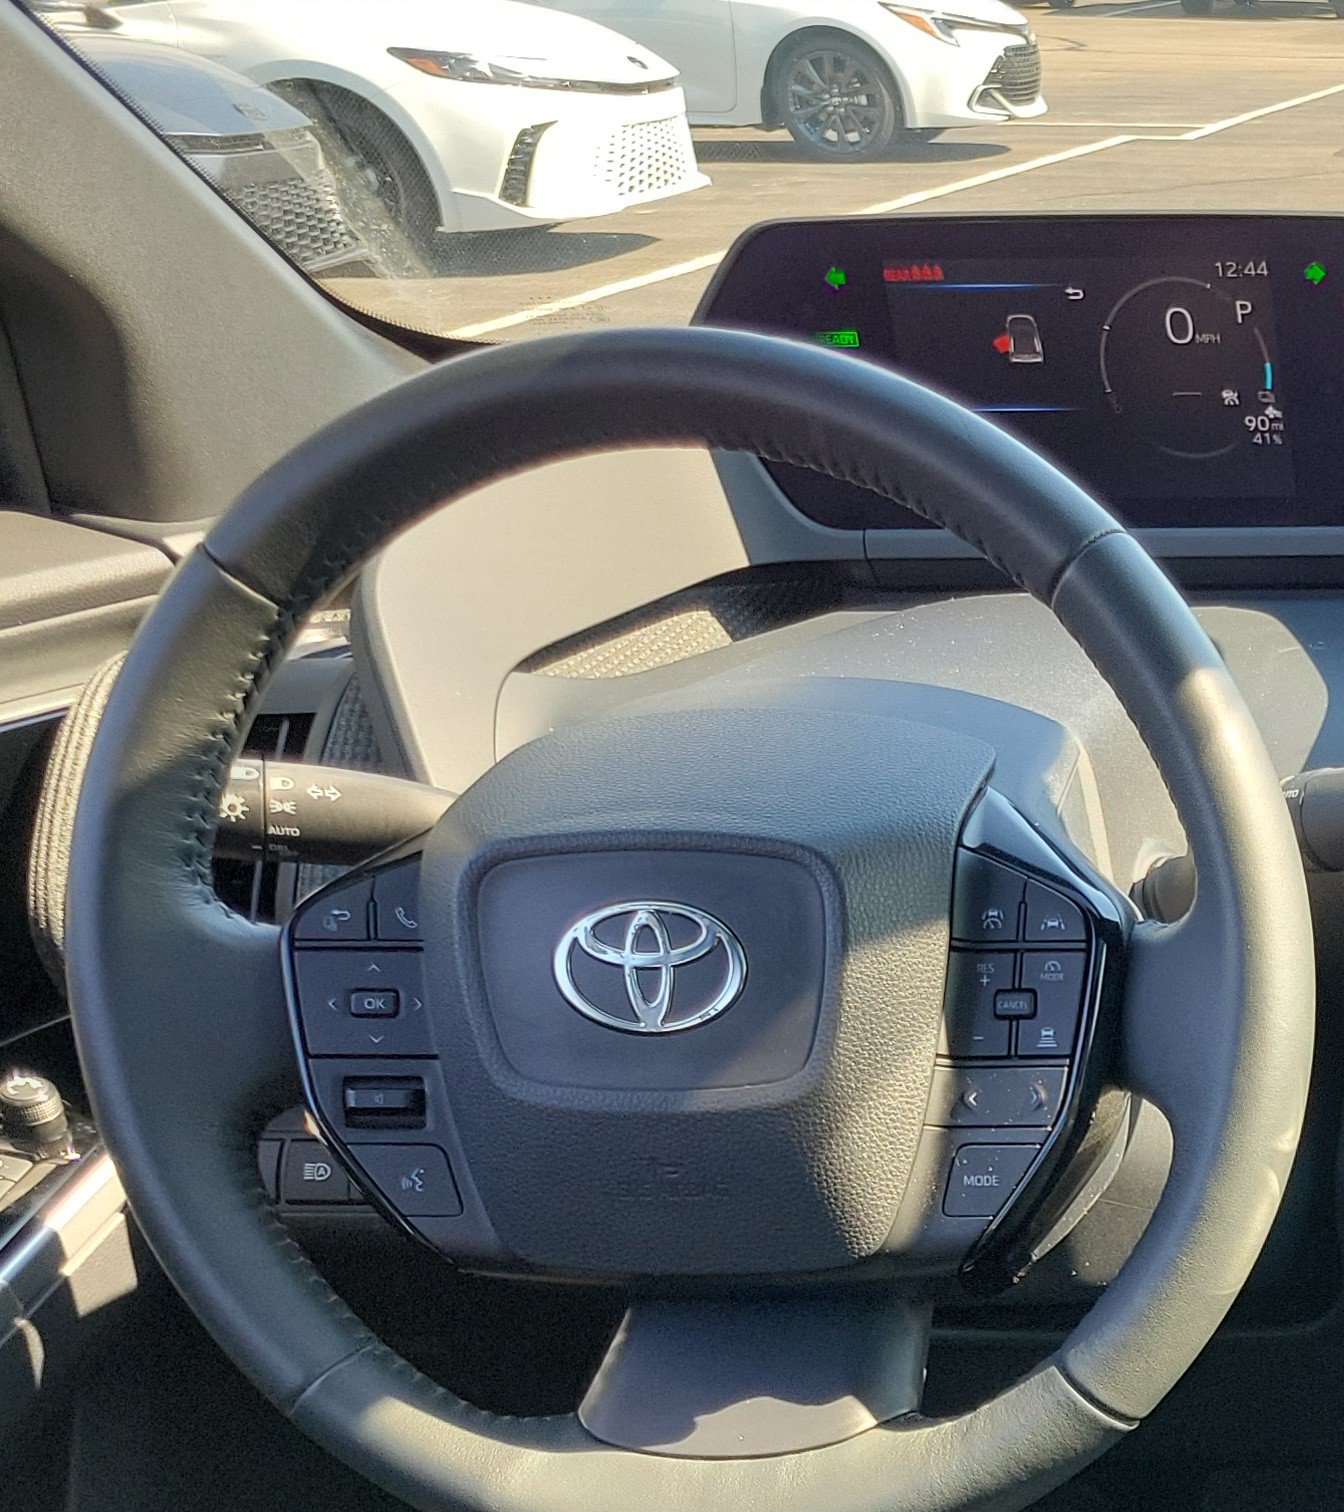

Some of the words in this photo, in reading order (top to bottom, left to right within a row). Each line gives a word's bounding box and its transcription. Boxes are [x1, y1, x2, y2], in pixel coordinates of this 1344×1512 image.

[1215, 261, 1269, 278] 12:44
[1235, 300, 1253, 324] P
[1165, 307, 1194, 345] 0
[1196, 333, 1221, 345] MPH
[1244, 415, 1270, 432] 90
[1253, 433, 1284, 446] 41%
[266, 824, 300, 837] AUTO
[1039, 972, 1064, 983] MODE
[364, 998, 386, 1011] OK
[998, 1000, 1029, 1011] CANCEL
[963, 1173, 1000, 1188] MODE
